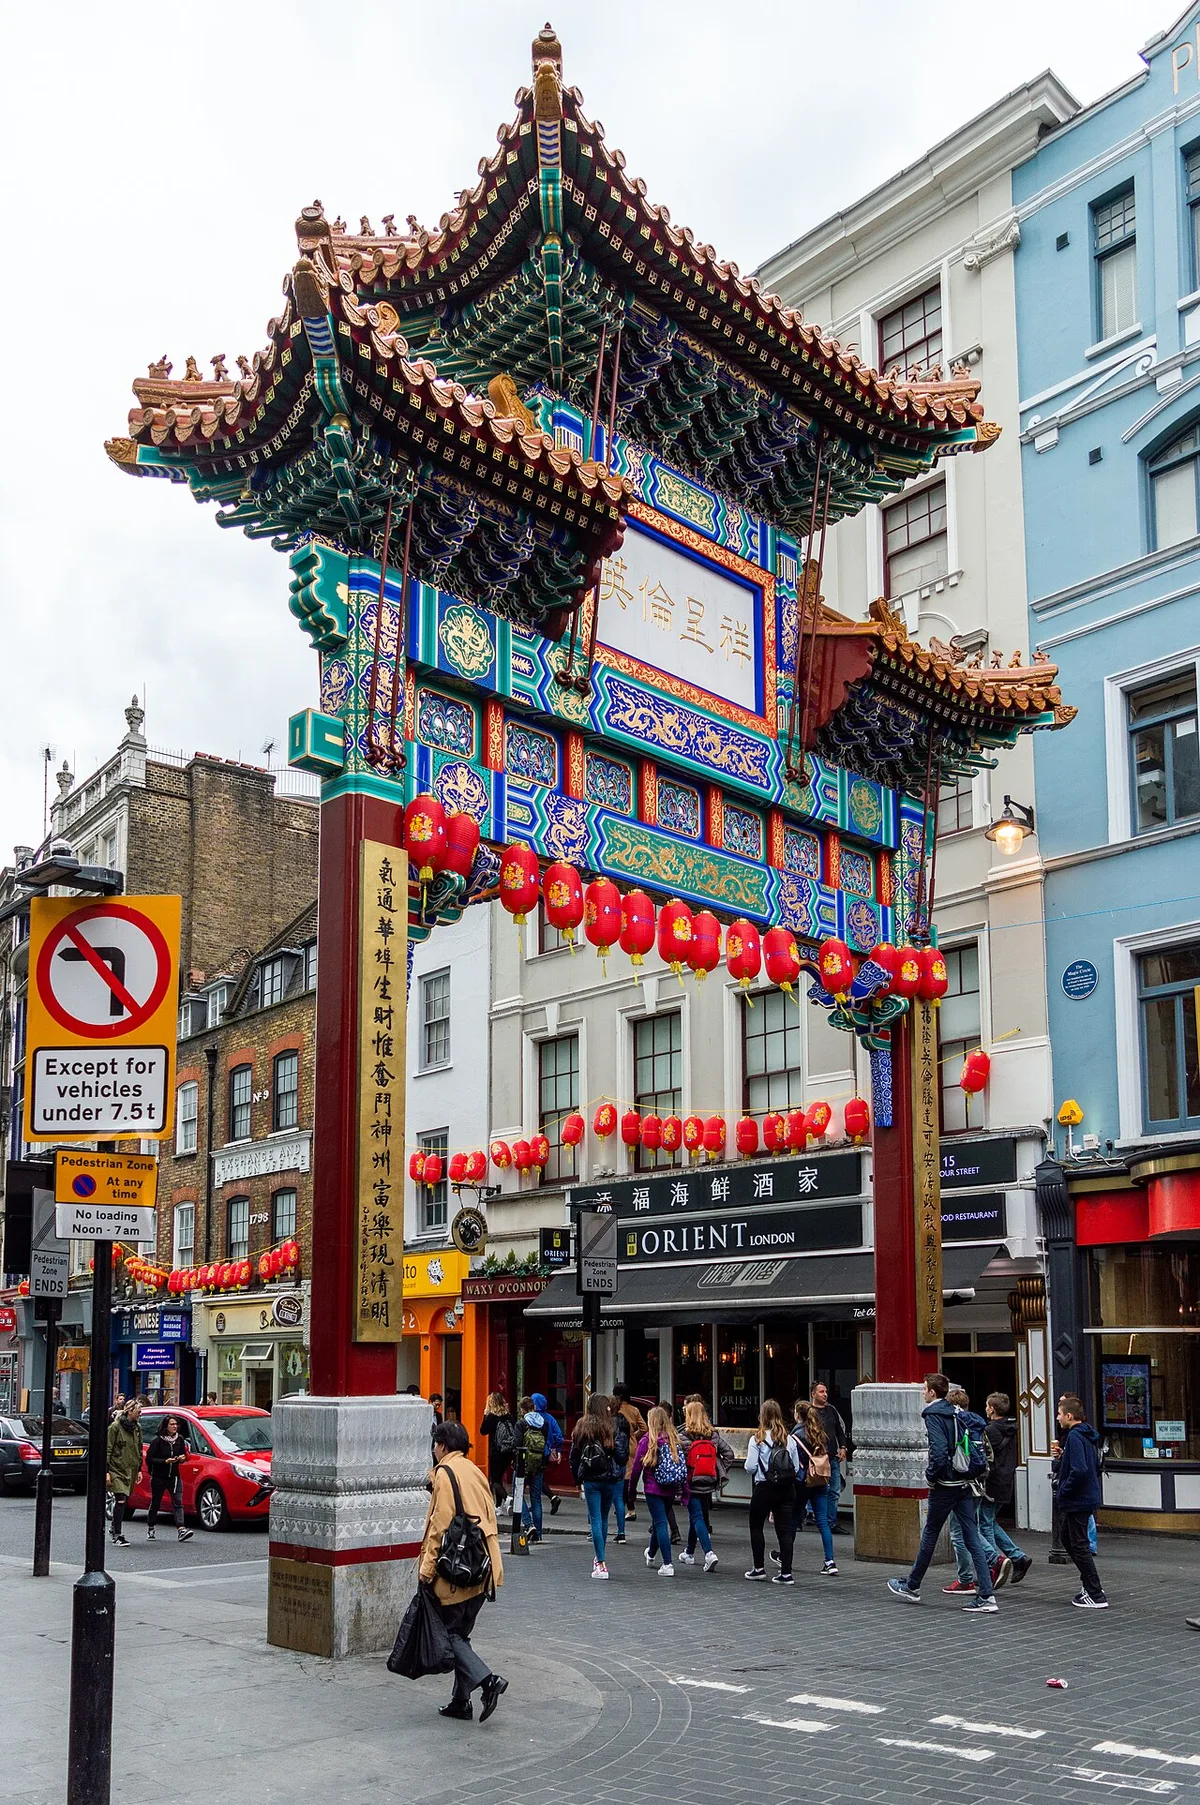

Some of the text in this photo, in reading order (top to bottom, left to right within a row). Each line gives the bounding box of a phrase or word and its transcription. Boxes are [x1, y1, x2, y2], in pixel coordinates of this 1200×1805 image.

[45, 1057, 156, 1078] Except for
[57, 1080, 143, 1098] vehicles
[42, 1103, 102, 1121] under
[61, 1156, 154, 1171] Pedestrian Zone
[221, 1143, 301, 1171] EXCHANGE AND
[942, 1155, 955, 1168] 15
[216, 1154, 306, 1182] BULLION OFFICE
[955, 1166, 980, 1176] STREET
[106, 1176, 143, 1189] At any
[112, 1189, 138, 1199] time
[75, 1209, 138, 1223] No loading
[249, 1212, 269, 1225] 1798
[955, 1210, 999, 1220] RESTAURANT
[72, 1223, 103, 1234] Noon
[641, 1222, 748, 1255] ORIENT
[750, 1231, 796, 1246] LONDON
[33, 1254, 68, 1266] Pedestrian
[544, 1249, 569, 1258] ORIENT
[42, 1265, 58, 1275] Zone
[583, 1260, 616, 1268] Pedestrian
[592, 1267, 607, 1276] Zone
[34, 1279, 64, 1293] ENDS
[586, 1278, 613, 1288] ENDS
[465, 1285, 494, 1296] WAXY
[133, 1312, 160, 1329] CHINESE
[720, 1395, 759, 1406] ORIENT
